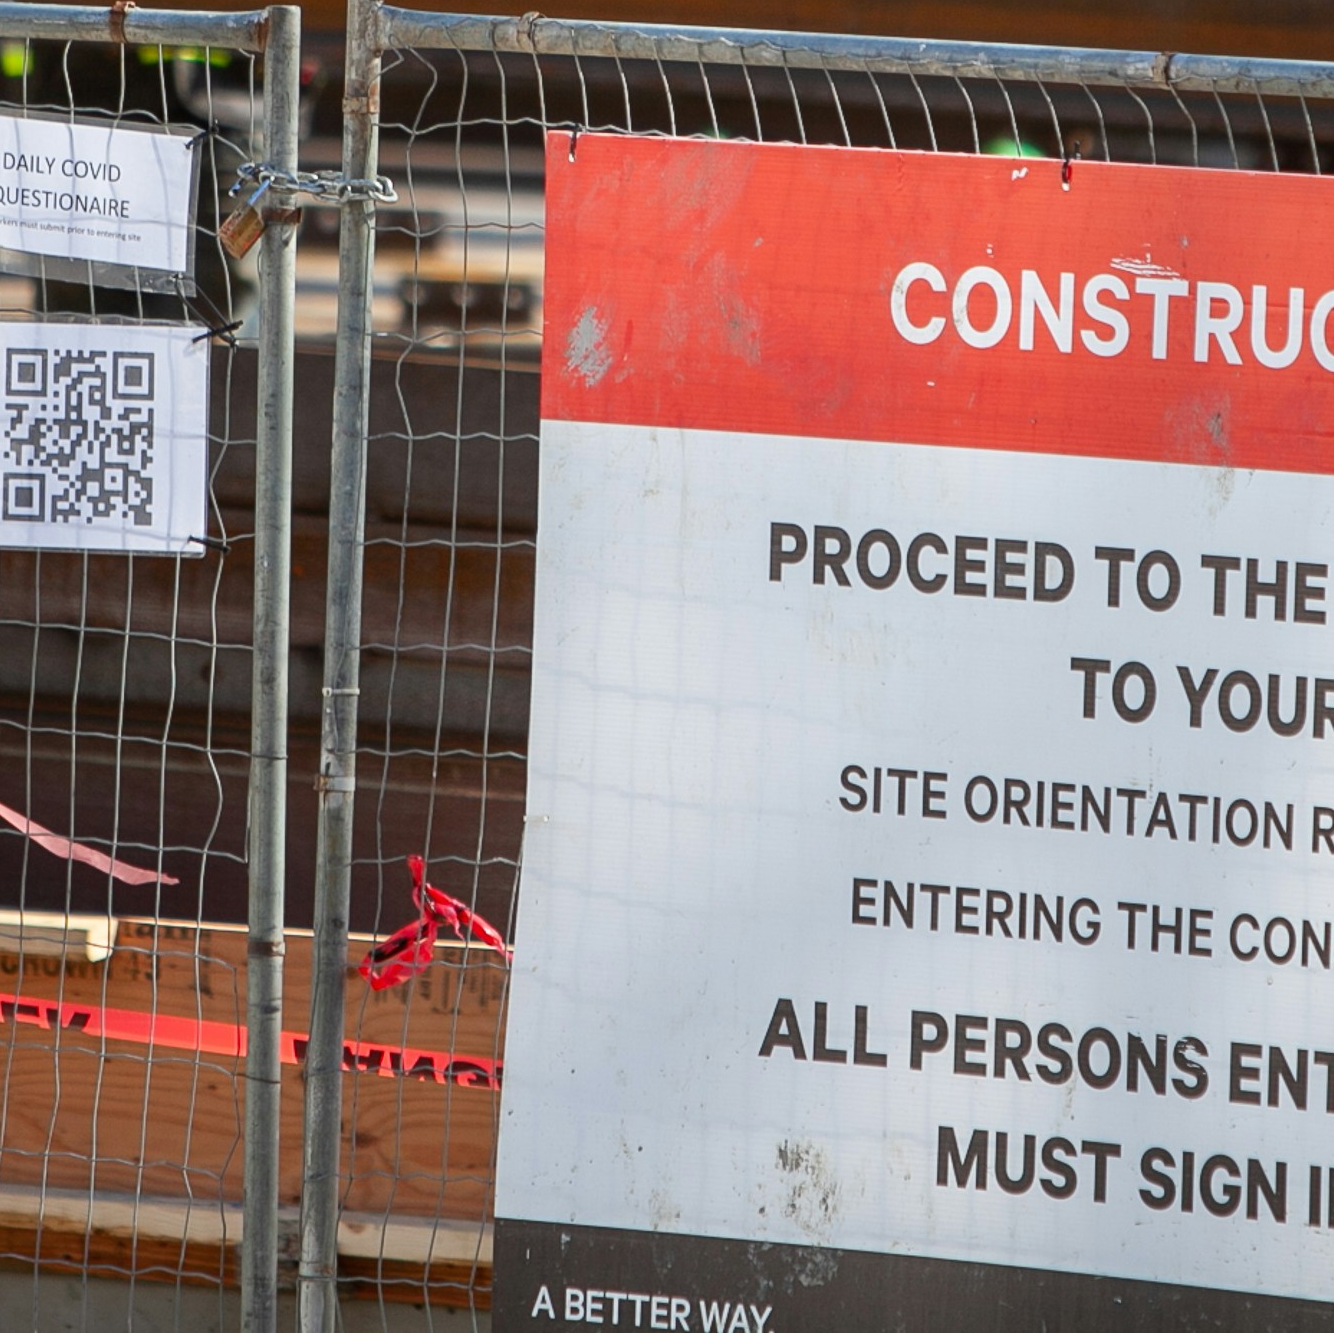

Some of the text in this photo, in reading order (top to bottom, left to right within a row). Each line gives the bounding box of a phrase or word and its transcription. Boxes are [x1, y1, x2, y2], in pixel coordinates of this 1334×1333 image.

[3, 152, 121, 183] DAILY COVID
[768, 521, 1075, 603] PROCEED
[1094, 545, 1182, 613] TO
[1200, 553, 1329, 626] THE
[1070, 656, 1157, 724] TO
[838, 764, 948, 820] SITE
[963, 774, 1295, 852] ORIENTATION
[851, 876, 1102, 946] ENTERING
[1117, 901, 1214, 958] THE
[757, 997, 888, 1069] ALL
[909, 1008, 1209, 1100] PERSONS
[936, 1124, 1122, 1205] MUST
[1138, 1146, 1288, 1224] SIGN
[531, 1285, 775, 1333] A BETTER WAY.
